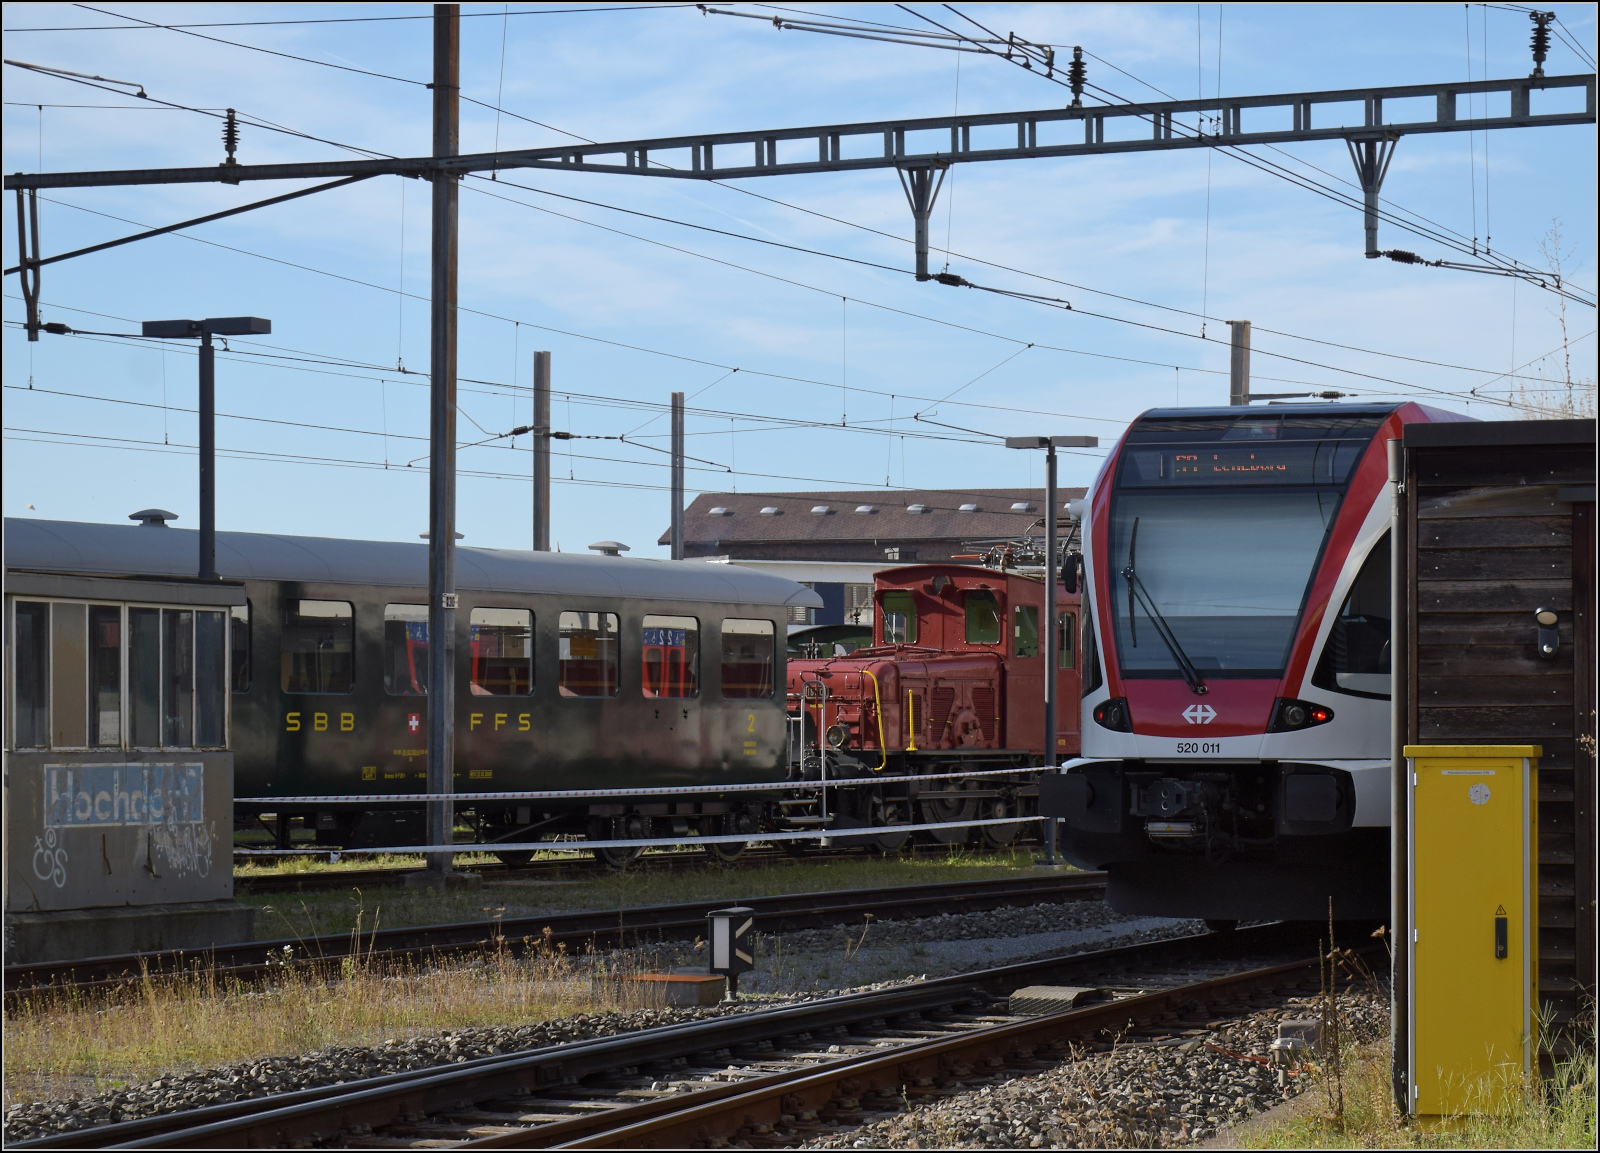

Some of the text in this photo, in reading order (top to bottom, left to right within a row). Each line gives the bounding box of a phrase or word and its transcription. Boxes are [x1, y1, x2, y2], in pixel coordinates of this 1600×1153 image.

[286, 711, 354, 732] SBB
[471, 712, 531, 732] FFS
[747, 714, 755, 732] 2
[1176, 742, 1220, 754] 520 011
